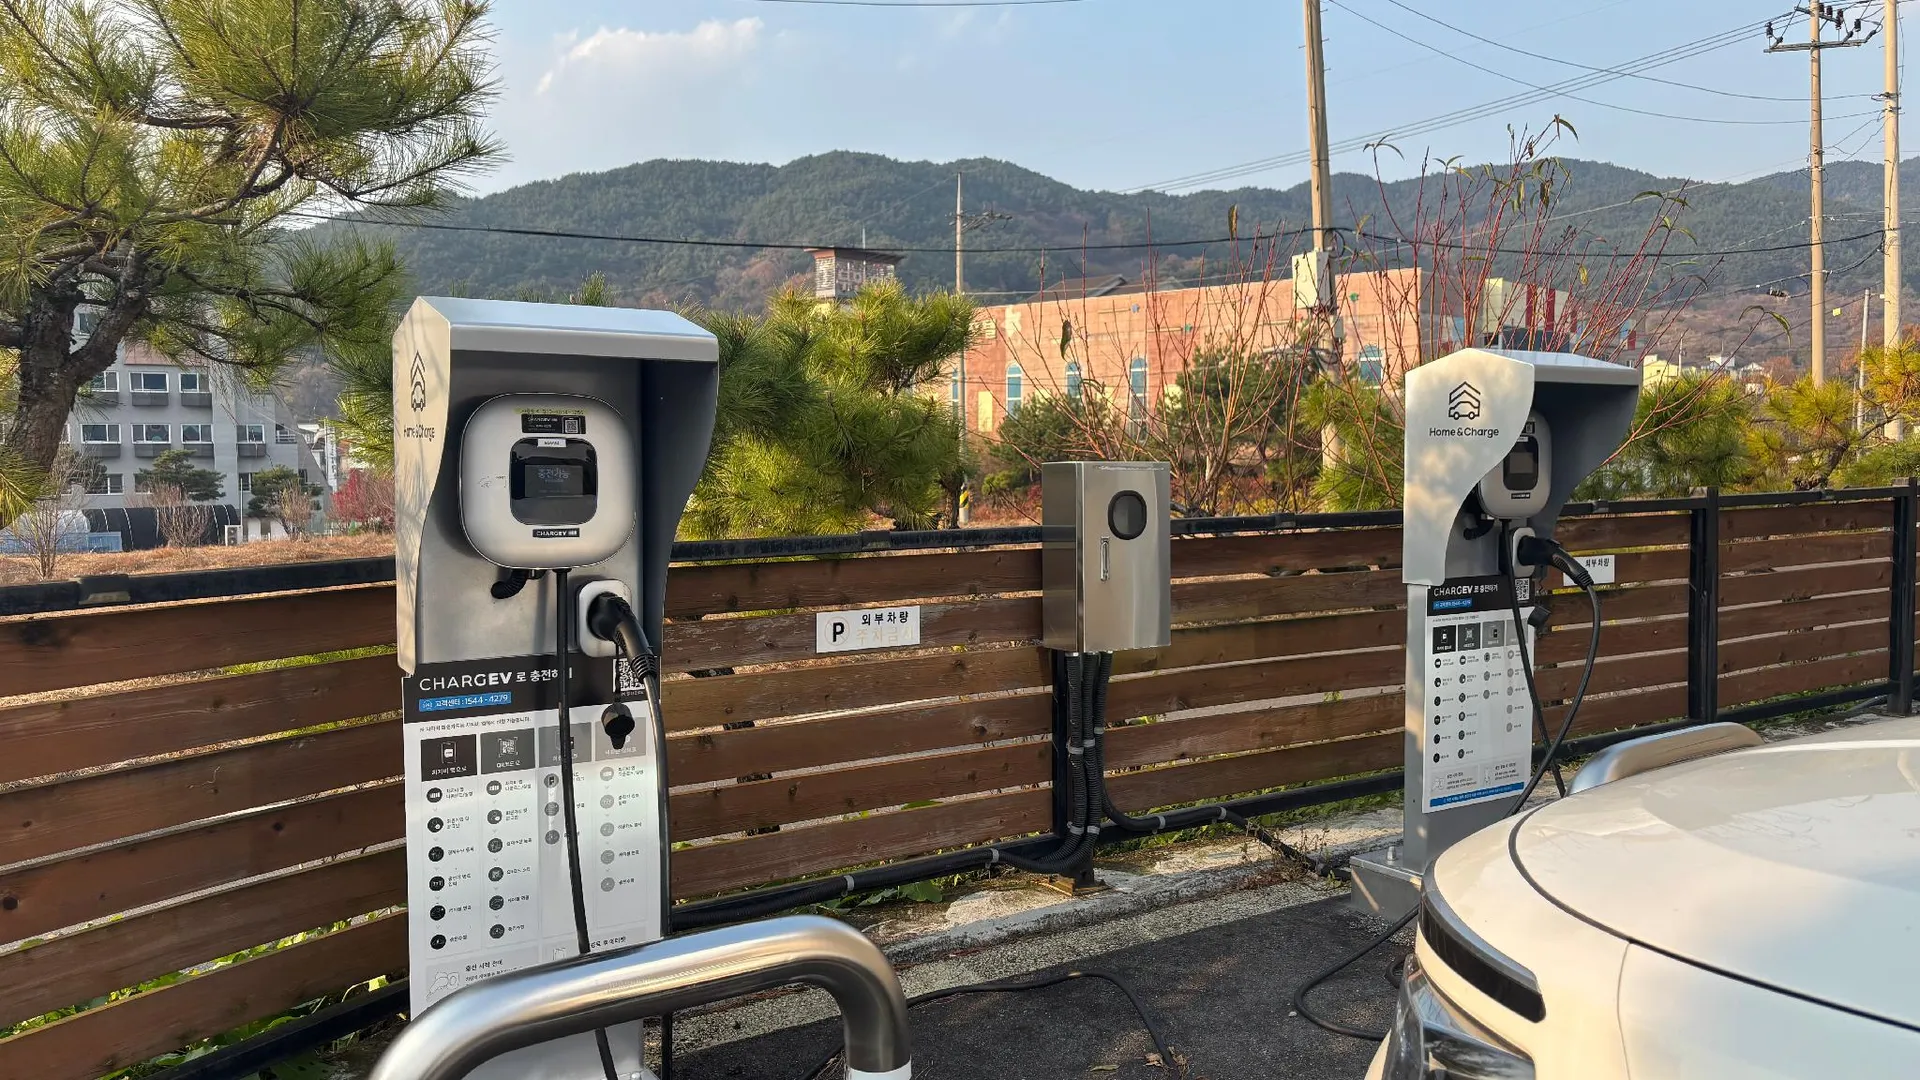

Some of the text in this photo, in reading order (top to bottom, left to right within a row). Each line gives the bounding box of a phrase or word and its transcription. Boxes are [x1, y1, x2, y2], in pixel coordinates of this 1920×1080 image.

[1433, 585, 1473, 597] CHARGEV
[861, 611, 909, 626] 외부차량
[832, 621, 845, 643] P
[419, 671, 513, 691] CHARGEV
[515, 671, 527, 683] 로
[435, 698, 461, 707] 고객센터
